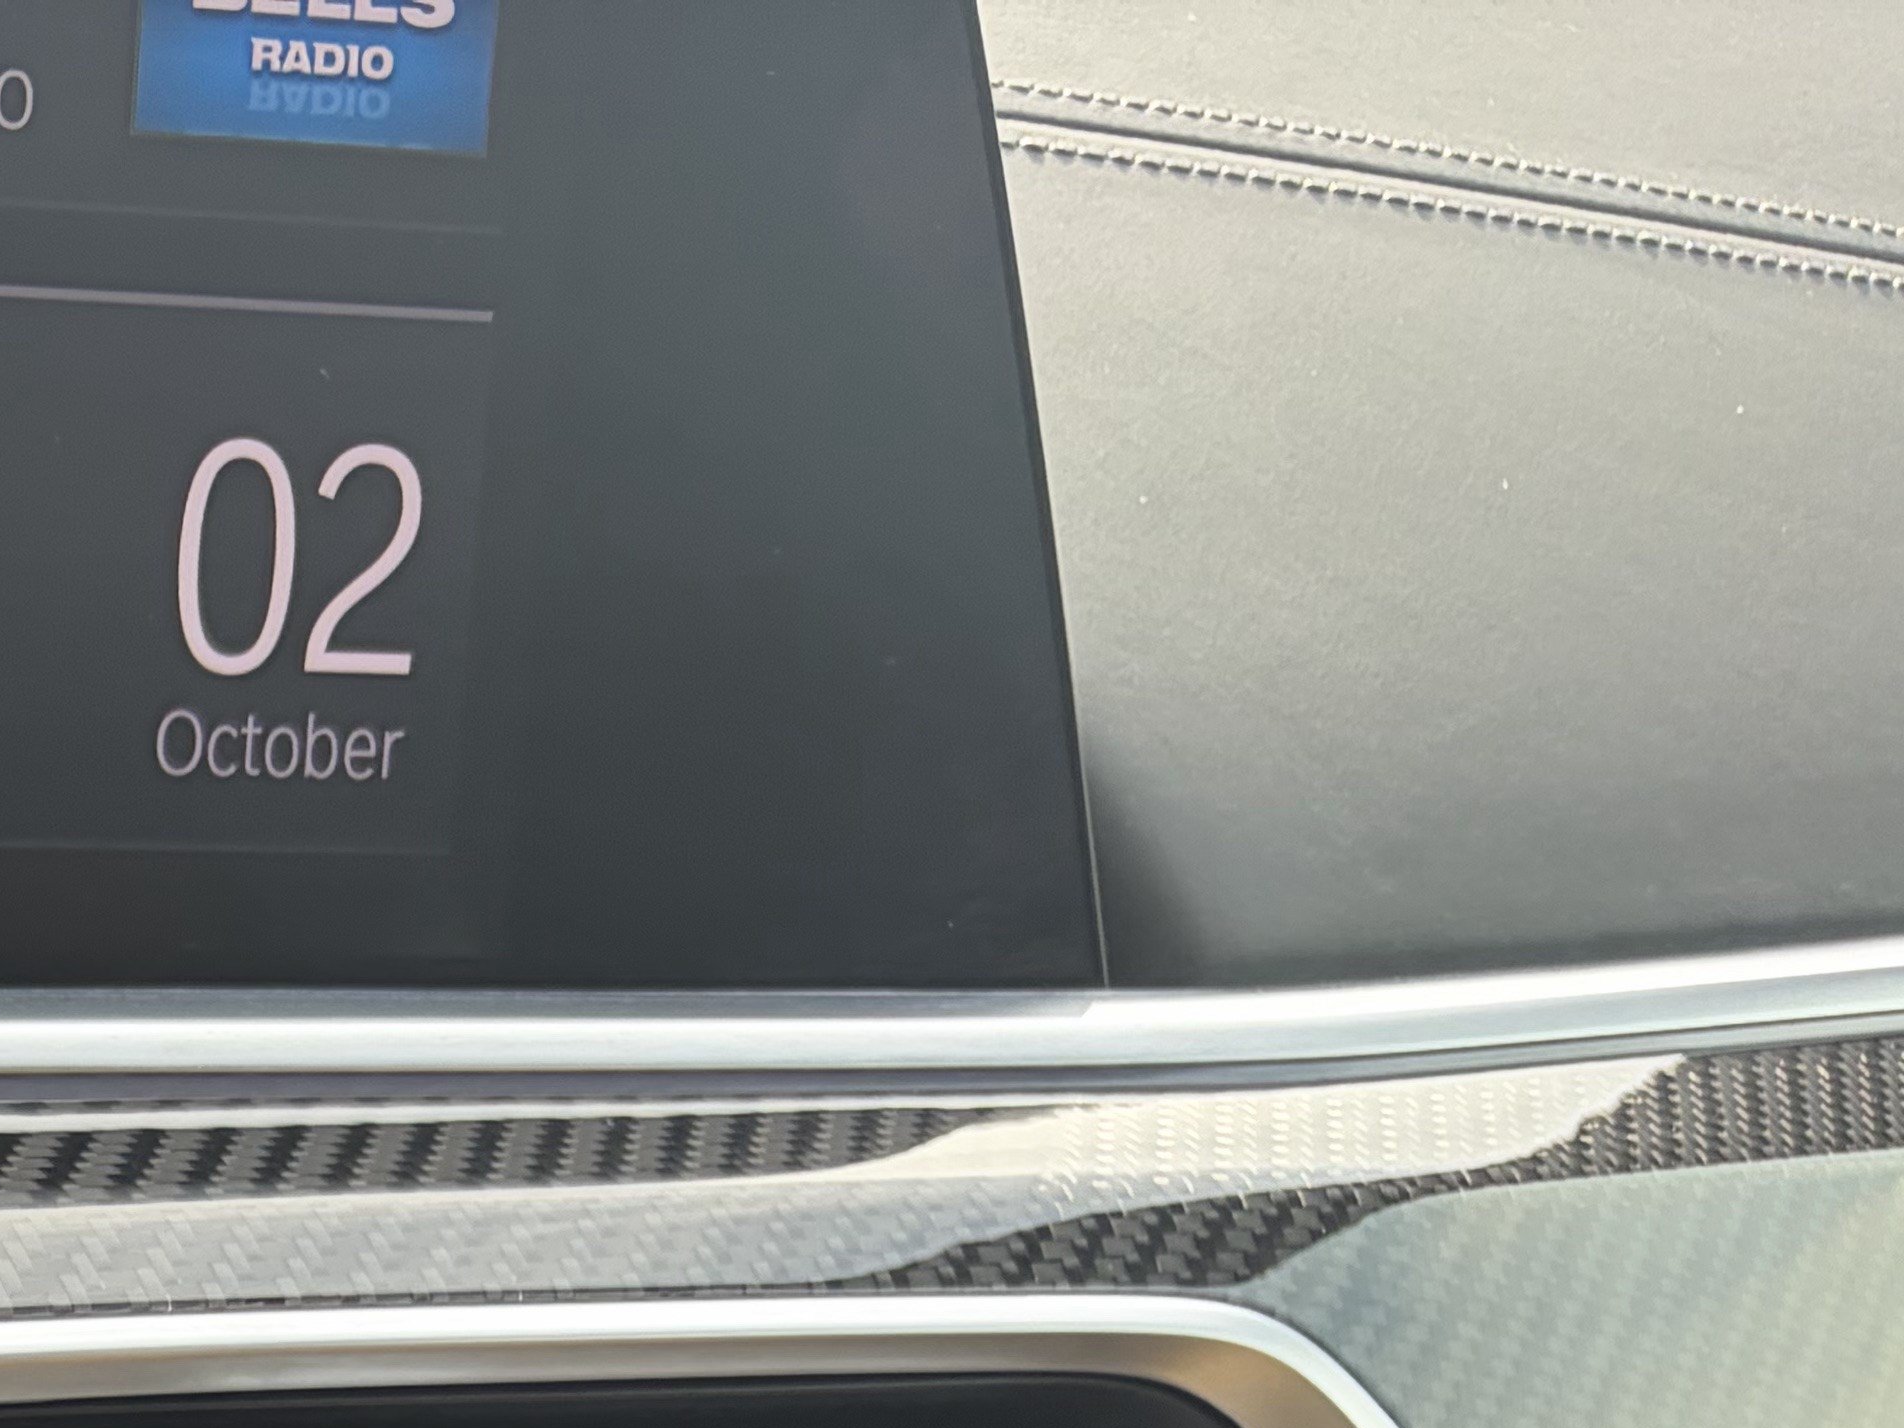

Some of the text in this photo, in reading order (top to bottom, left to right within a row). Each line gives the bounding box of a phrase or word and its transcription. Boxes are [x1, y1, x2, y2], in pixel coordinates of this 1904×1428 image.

[249, 36, 395, 80] RADIO
[178, 437, 423, 676] 02
[156, 708, 405, 781] October
